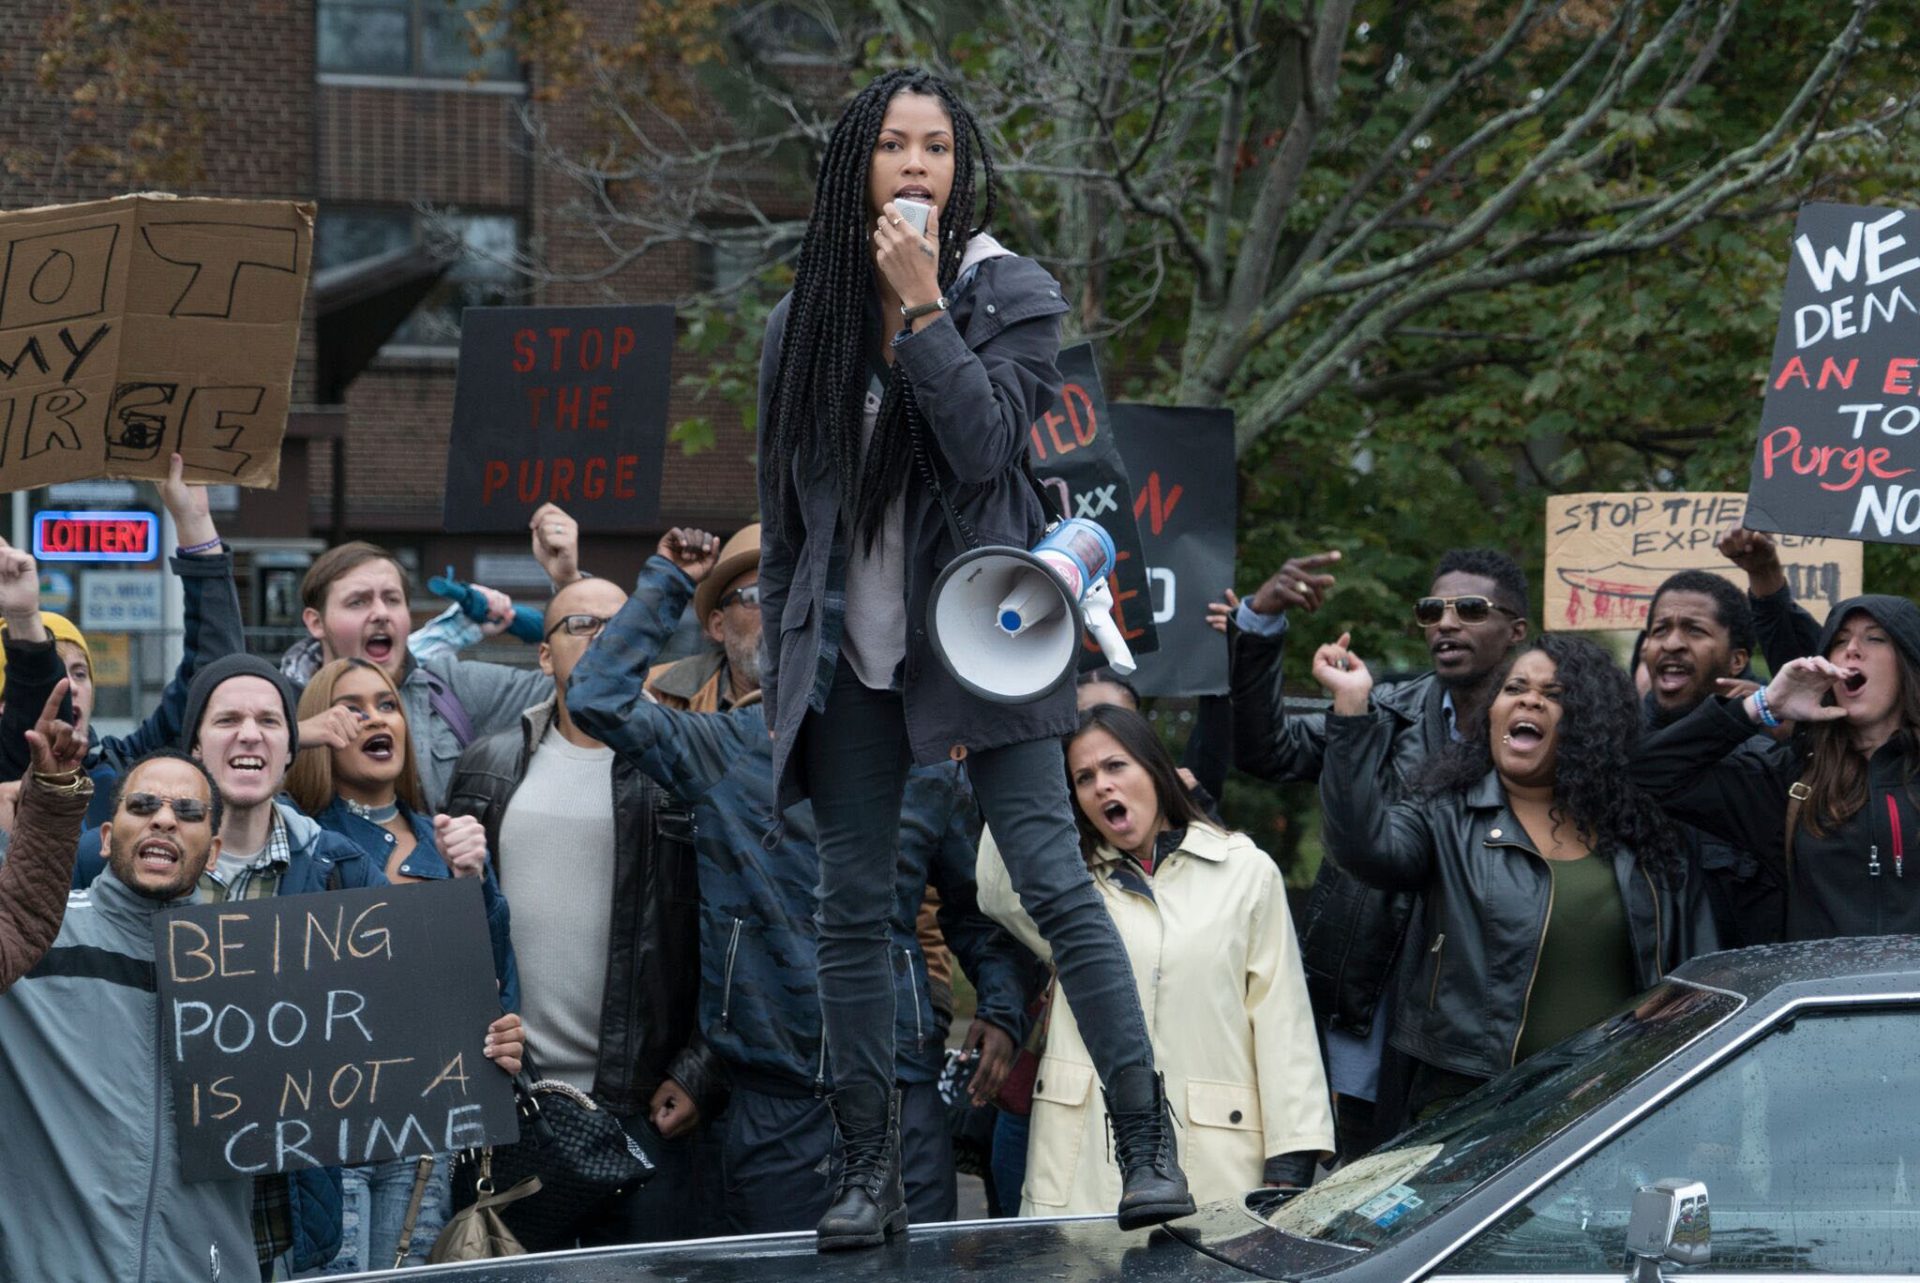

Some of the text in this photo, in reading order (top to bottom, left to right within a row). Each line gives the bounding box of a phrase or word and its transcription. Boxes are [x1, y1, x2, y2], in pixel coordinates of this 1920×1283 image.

[1795, 210, 1920, 293] WE
[1794, 286, 1920, 349] DEM
[512, 327, 636, 373] STOP
[1774, 356, 1920, 396] AN E
[527, 385, 612, 431] THE
[1838, 403, 1920, 439] TO
[482, 453, 639, 506] PURGE
[1763, 426, 1916, 492] Purge
[42, 520, 148, 553] LOTTERY
[1556, 498, 1748, 535] STOP THE
[1849, 484, 1920, 538] NO
[169, 902, 392, 982] BEING
[174, 990, 373, 1061] POOR
[192, 1052, 470, 1127] IS NOT A
[224, 1104, 486, 1172] CRIME
